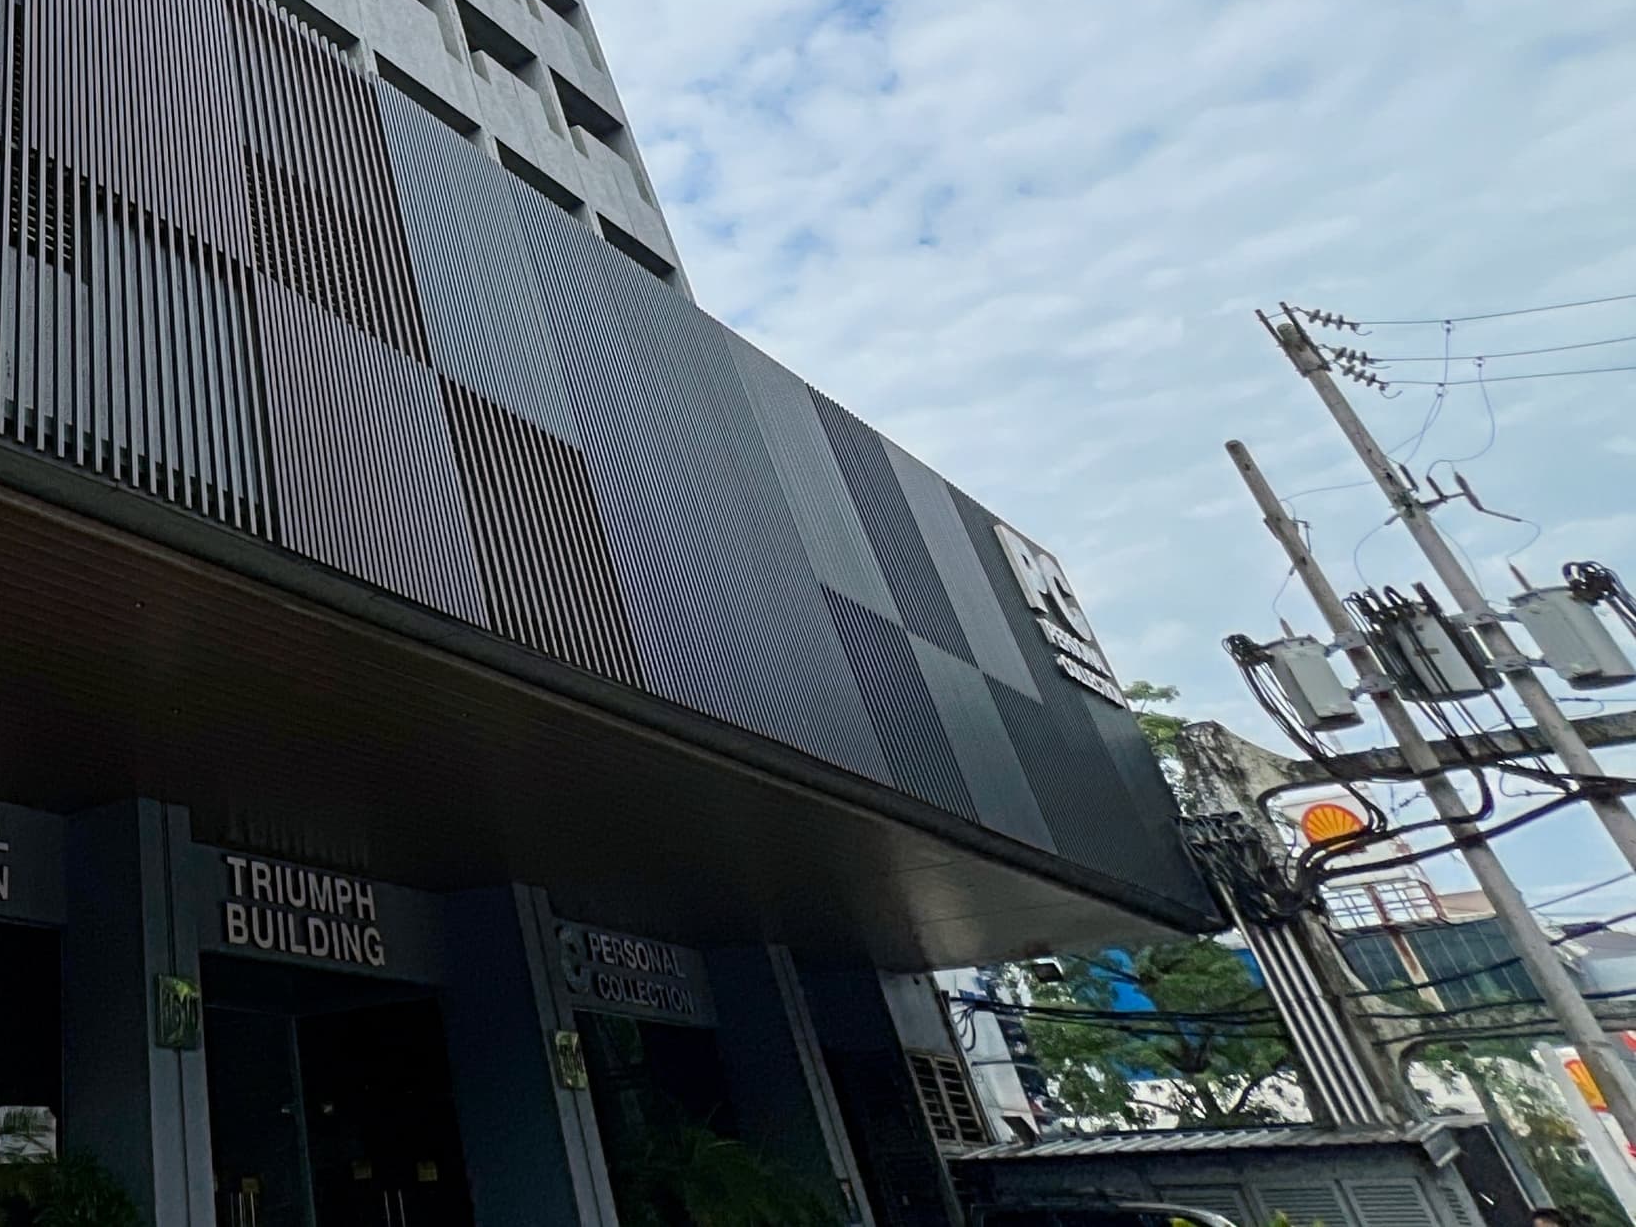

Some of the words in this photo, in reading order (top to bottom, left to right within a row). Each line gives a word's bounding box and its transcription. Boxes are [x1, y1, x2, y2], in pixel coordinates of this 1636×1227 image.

[226, 855, 376, 921] TRIUMPH
[225, 902, 386, 966] BUILDING
[587, 931, 687, 979] PERSONAL
[596, 973, 695, 1014] COLLECTION
